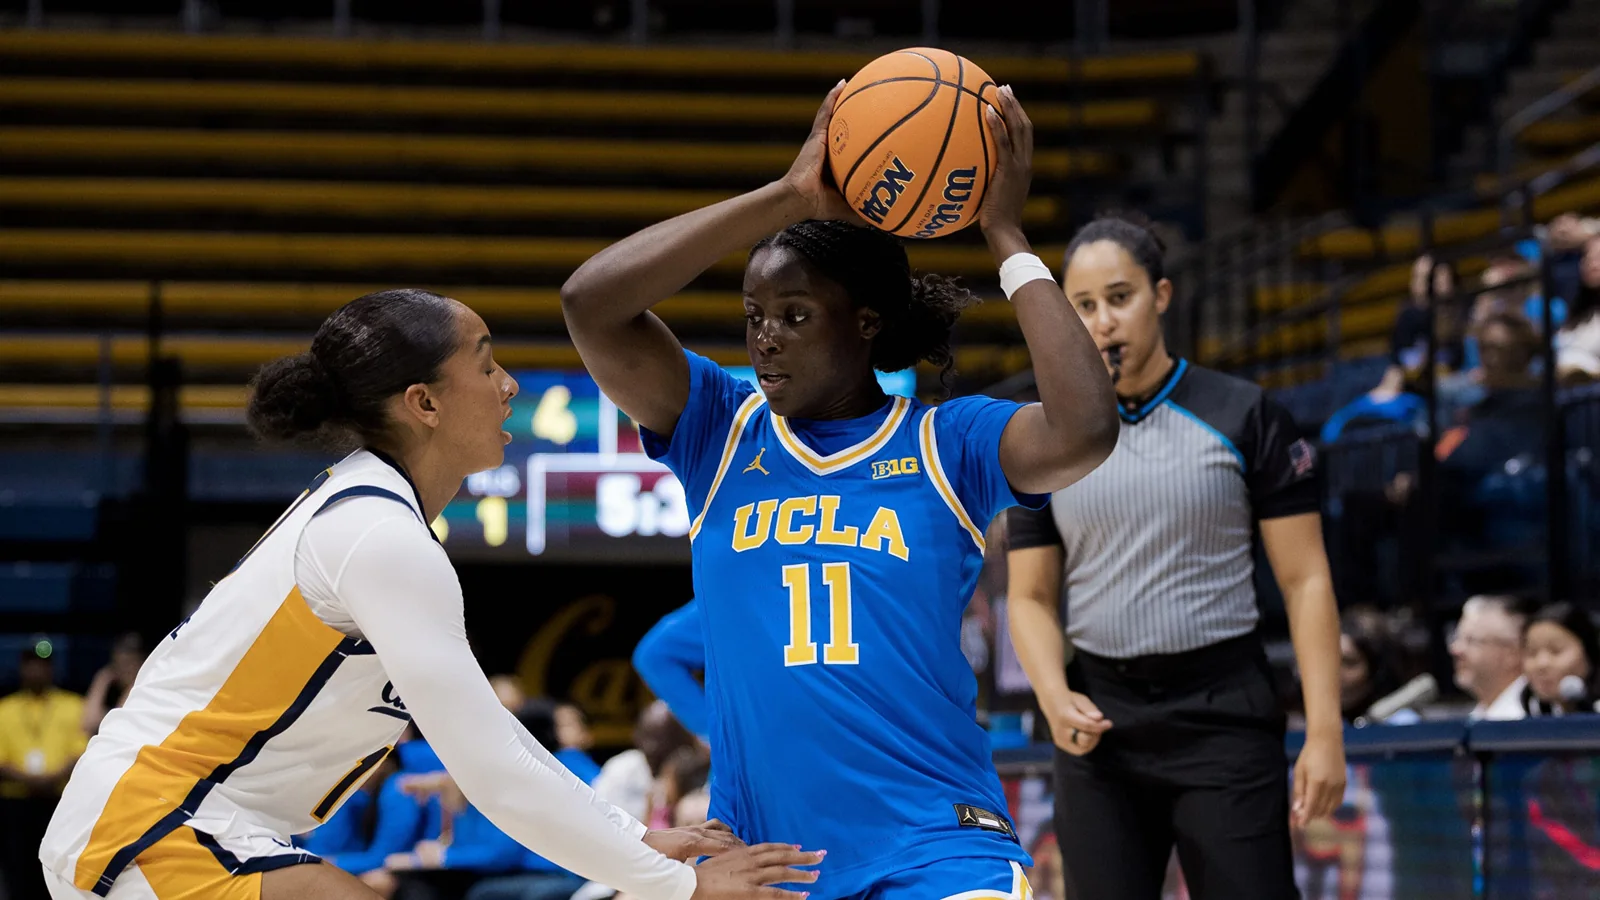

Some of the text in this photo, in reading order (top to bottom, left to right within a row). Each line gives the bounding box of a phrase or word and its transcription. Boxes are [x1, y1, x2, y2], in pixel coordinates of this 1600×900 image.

[858, 154, 916, 225] NCAA
[910, 166, 977, 238] Wilso
[596, 472, 691, 537] 5:3
[731, 495, 909, 561] UCLA
[782, 562, 859, 667] 11
